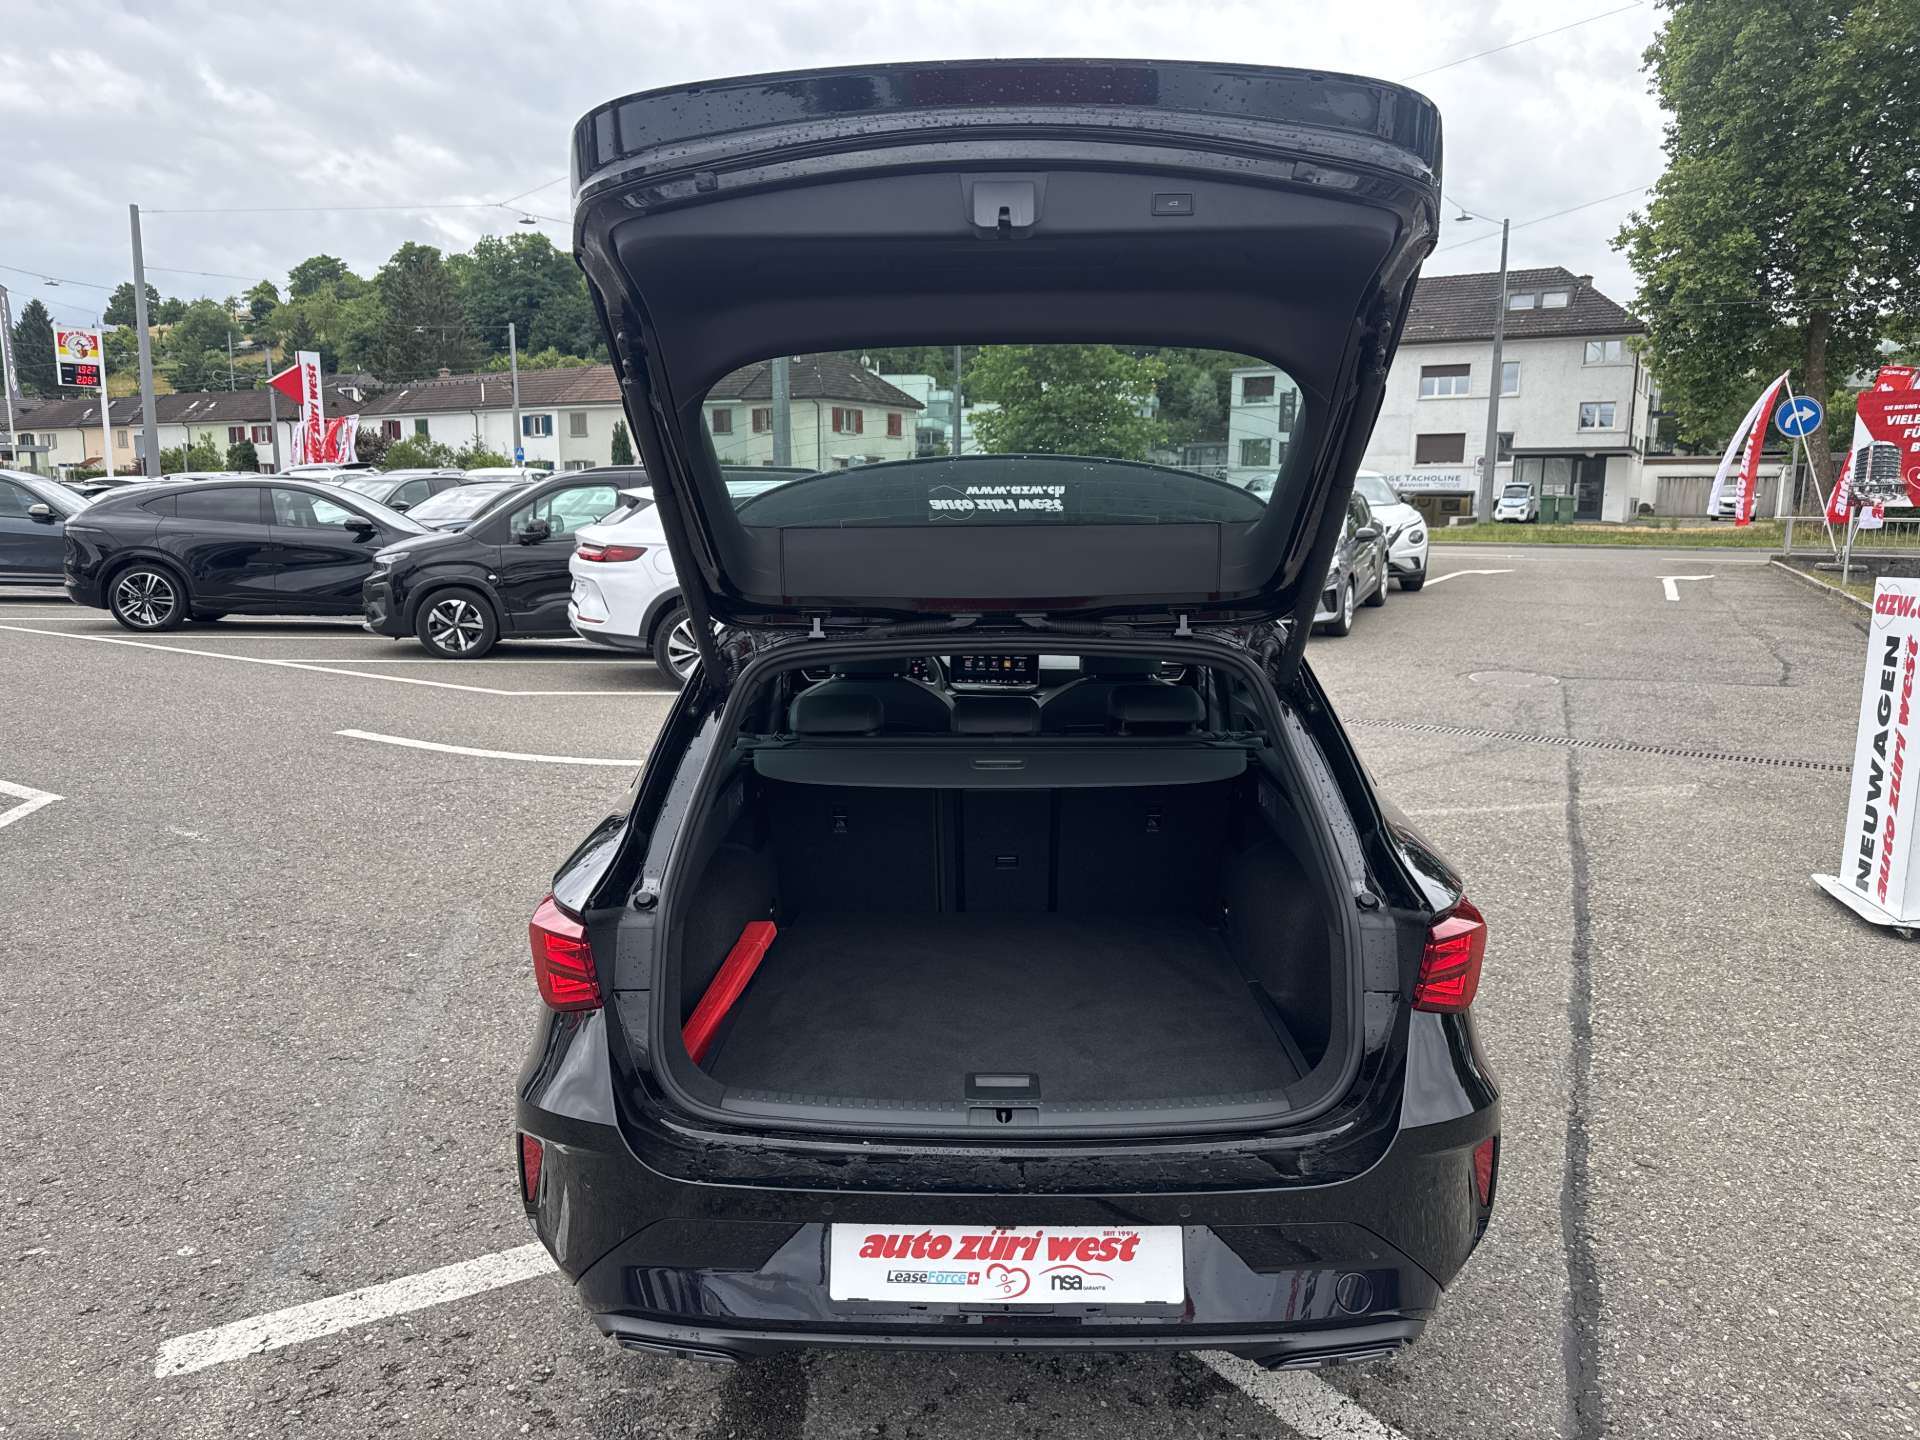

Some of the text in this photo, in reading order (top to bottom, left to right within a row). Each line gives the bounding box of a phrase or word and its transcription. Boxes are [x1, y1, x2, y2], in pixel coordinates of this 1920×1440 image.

[1406, 474, 1462, 482] TACHOLINE
[1856, 635, 1901, 893] NEUWAGEN
[1876, 632, 1920, 906] auto züri west
[859, 1229, 1140, 1262] auto züri west
[887, 1269, 967, 1285] LeaseForce
[1051, 1274, 1083, 1291] nsa
